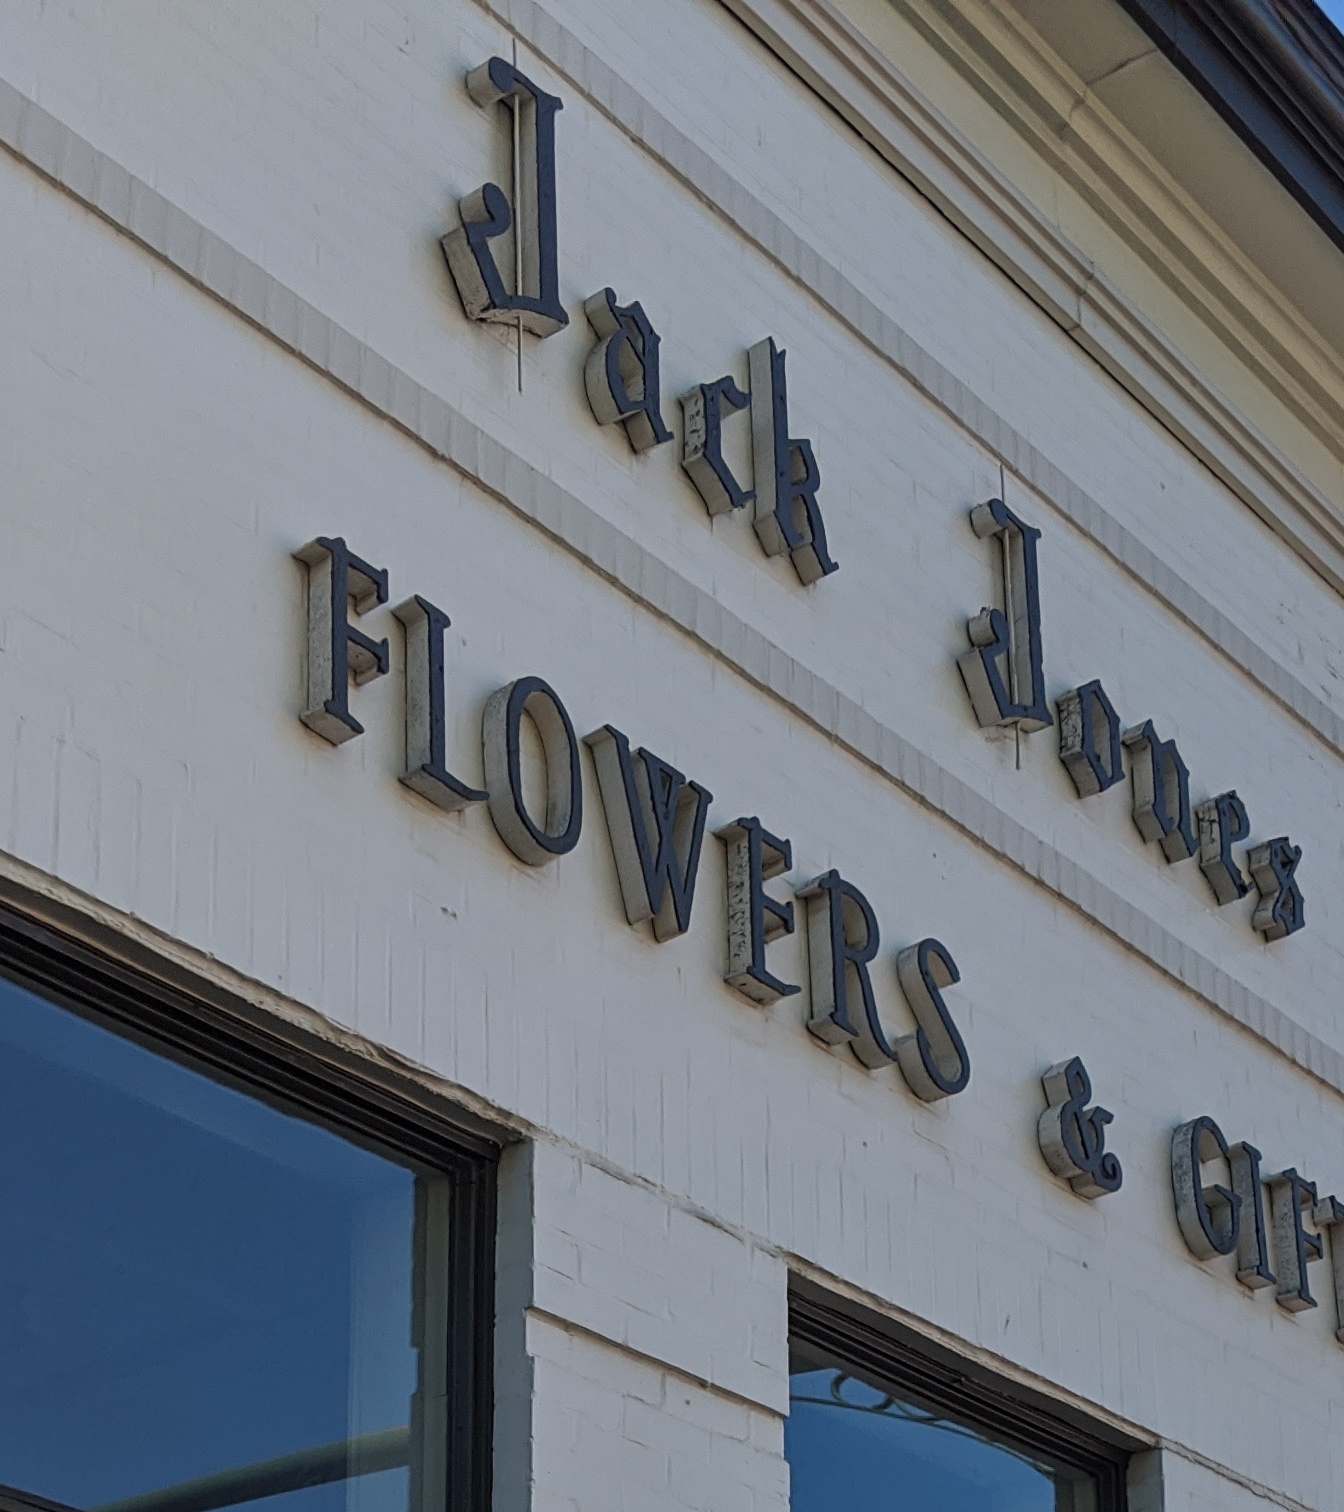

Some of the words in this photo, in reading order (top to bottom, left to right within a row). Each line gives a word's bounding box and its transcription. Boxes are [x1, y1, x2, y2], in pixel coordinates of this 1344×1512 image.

[293, 537, 971, 1101] FLOWERS
[1038, 1057, 1121, 1198] &
[442, 56, 839, 585] Jack
[956, 498, 1305, 942] Jones
